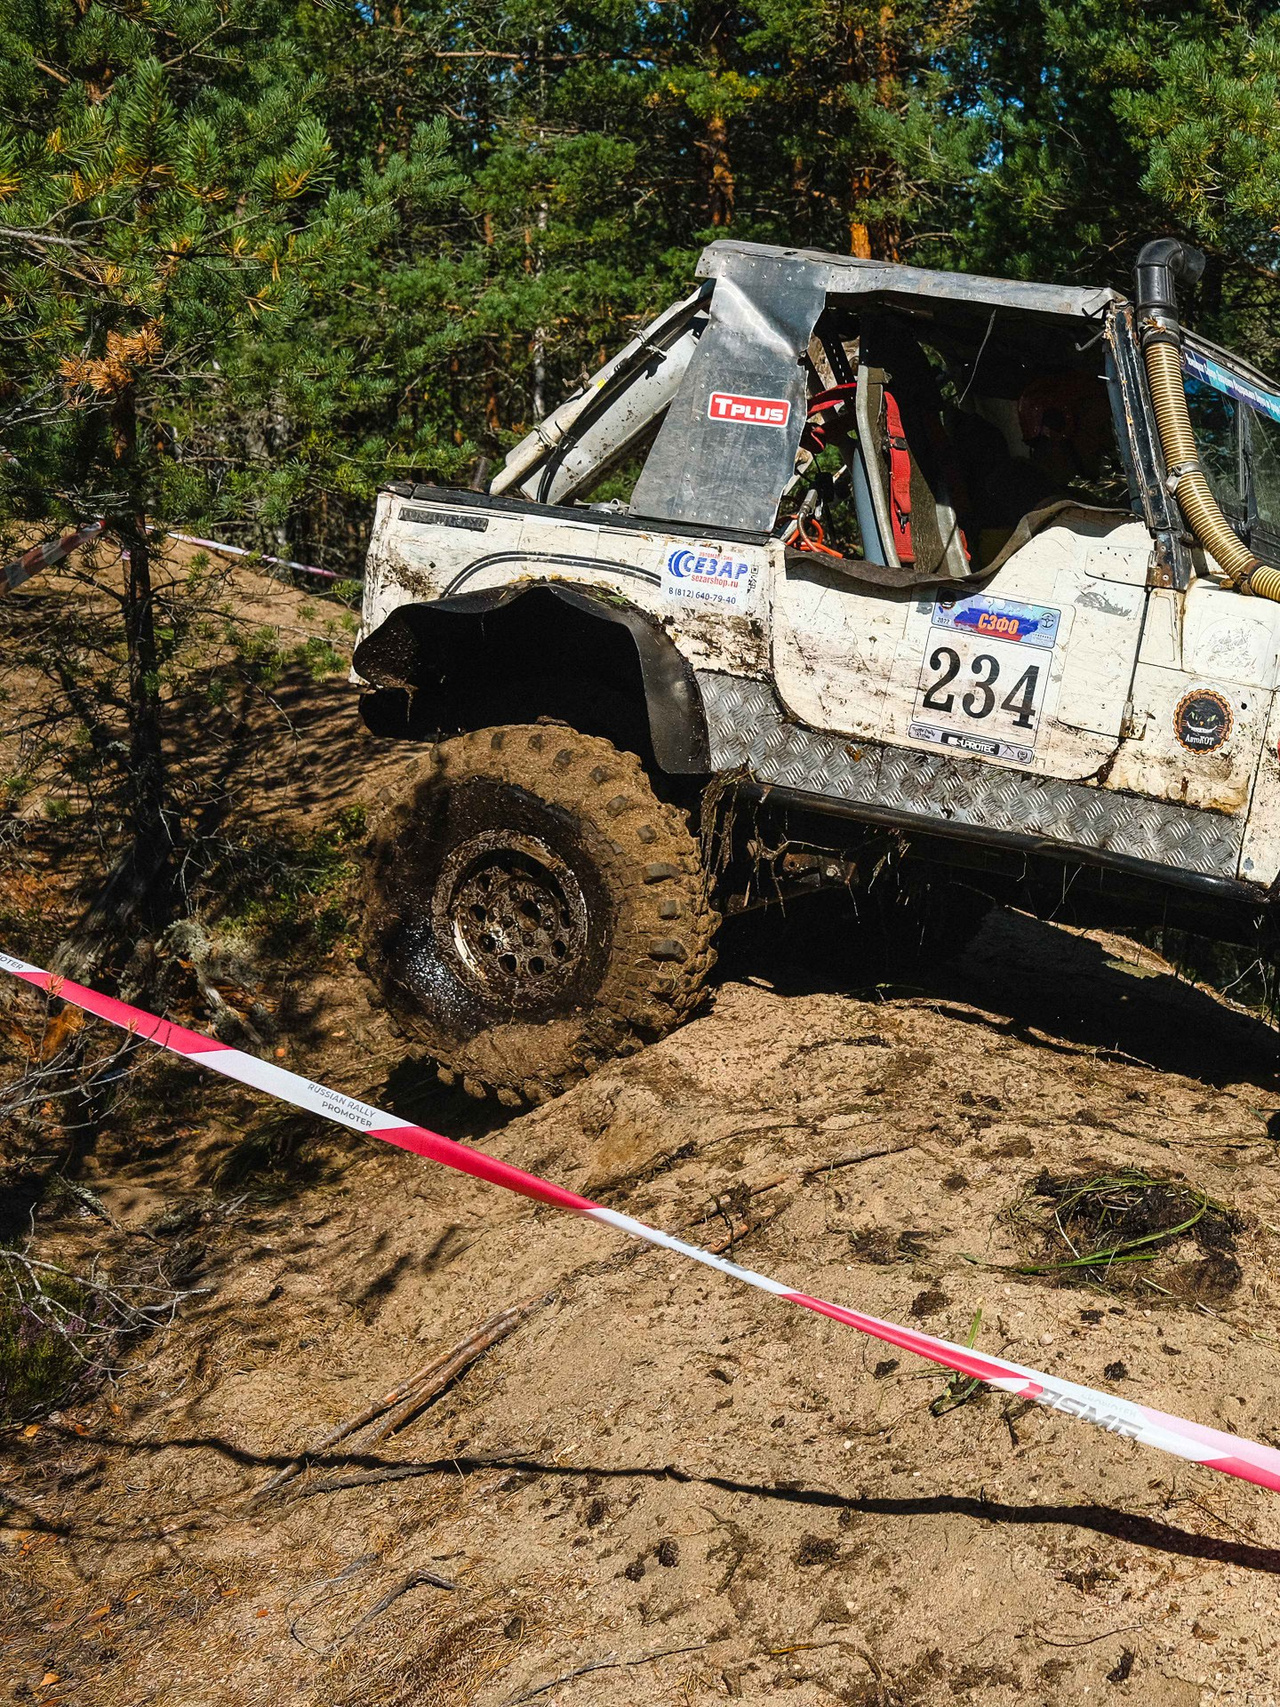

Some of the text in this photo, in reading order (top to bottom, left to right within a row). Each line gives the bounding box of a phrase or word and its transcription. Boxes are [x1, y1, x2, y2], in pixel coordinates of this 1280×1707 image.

[715, 397, 783, 421] TPLUS
[683, 555, 749, 580] СЕЗАР
[691, 574, 739, 588] sezarshop.ru
[668, 587, 737, 605] 8 (812) 640-79-40
[978, 612, 1020, 635] СЗФО
[922, 646, 1040, 730] 234
[307, 1083, 377, 1118] RUSSIAN RALLY
[321, 1100, 373, 1127] PROMOTER
